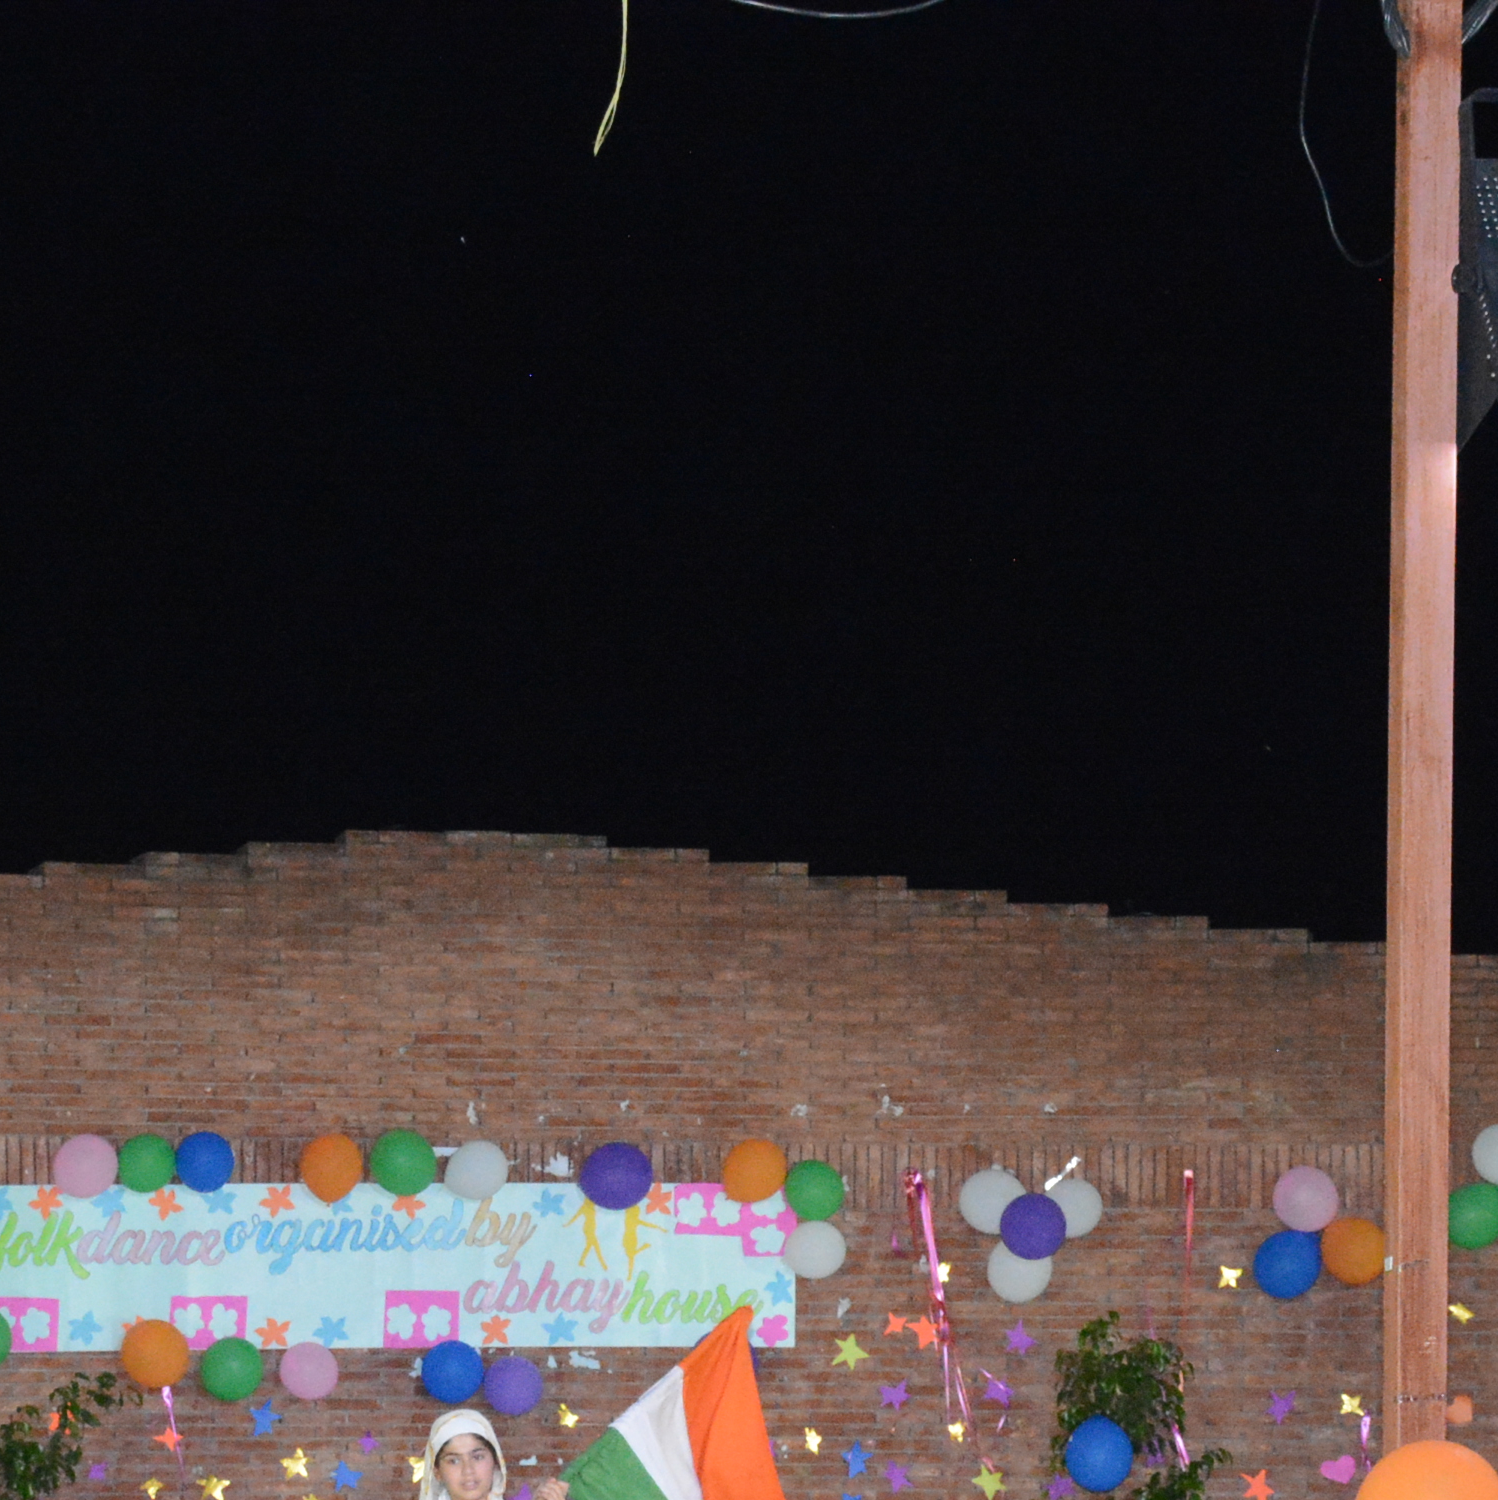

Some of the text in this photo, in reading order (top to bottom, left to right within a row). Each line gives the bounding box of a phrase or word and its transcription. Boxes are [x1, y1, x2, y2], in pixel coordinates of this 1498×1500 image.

[223, 1197, 467, 1276] organised
[464, 1196, 538, 1268] by
[462, 1260, 764, 1334] abhay house
